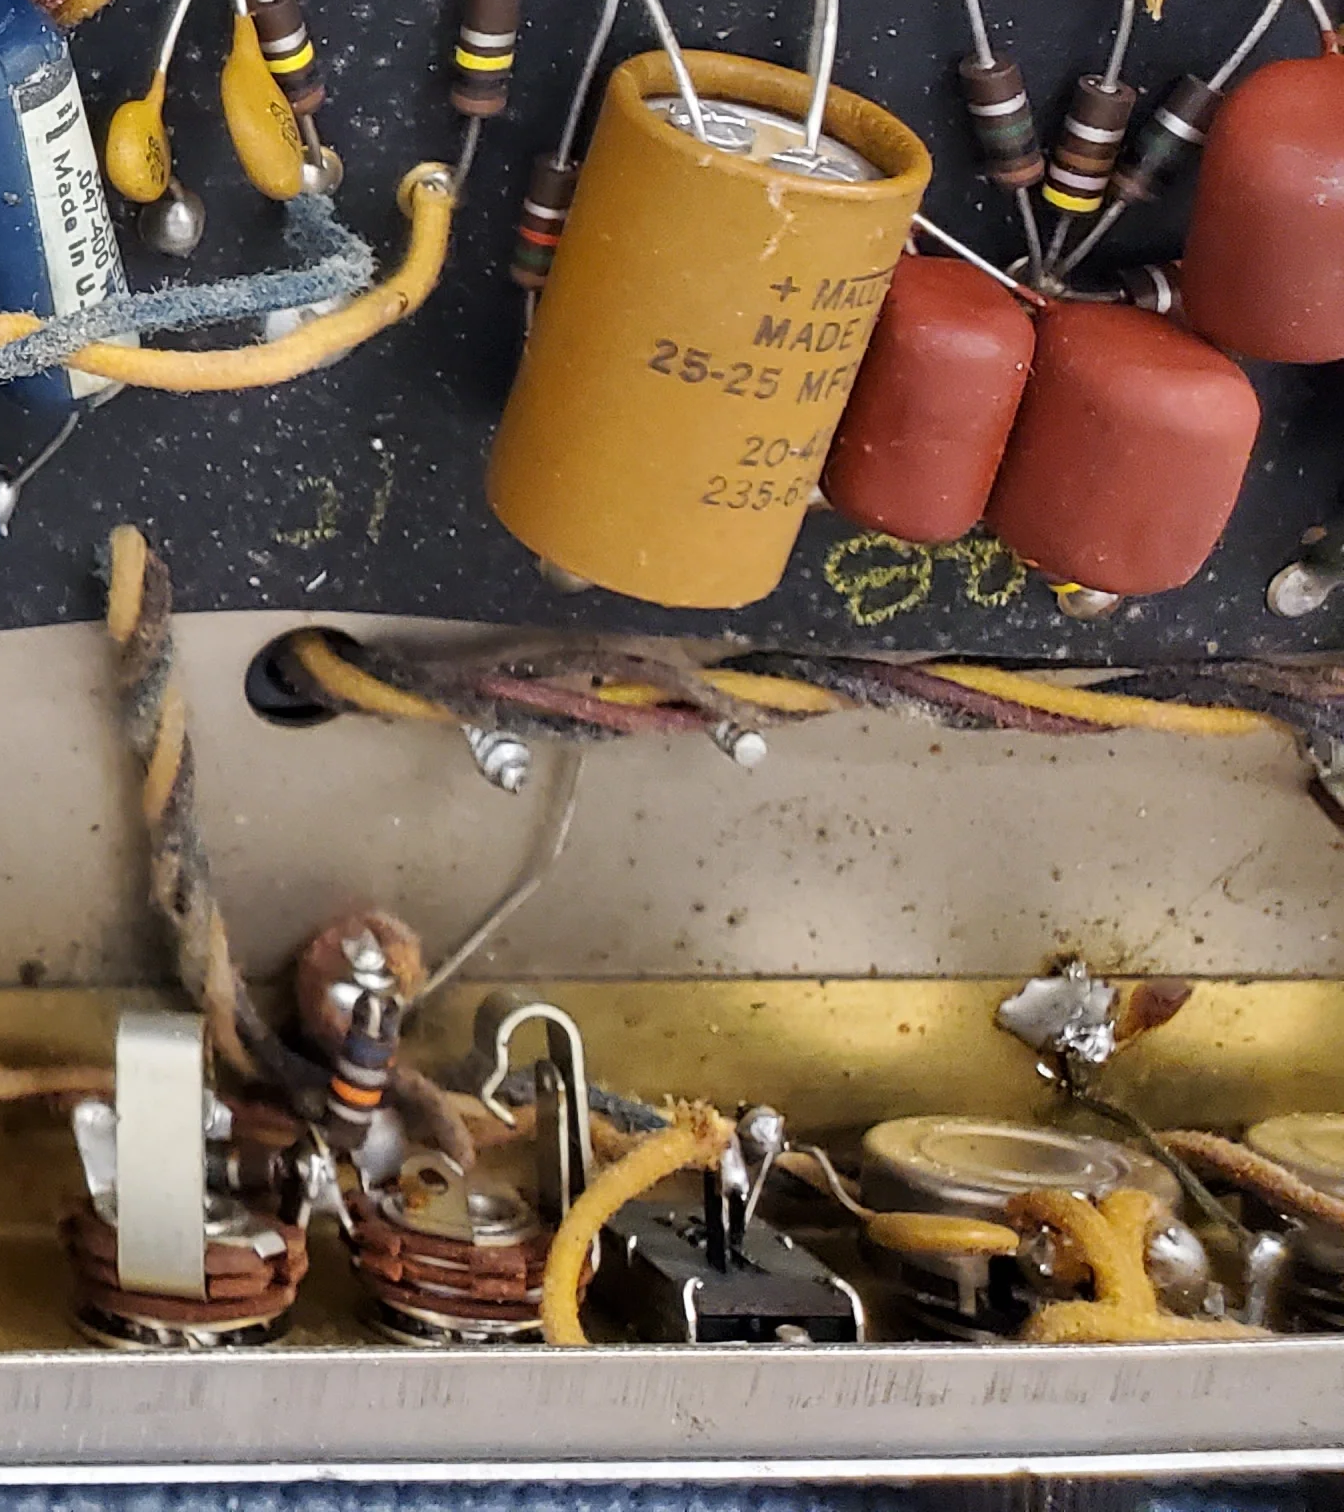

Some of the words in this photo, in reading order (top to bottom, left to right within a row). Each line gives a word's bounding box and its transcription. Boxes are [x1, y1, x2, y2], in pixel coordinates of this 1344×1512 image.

[52, 148, 79, 234] Made
[753, 315, 861, 353] MADE
[647, 339, 782, 400] 25-25
